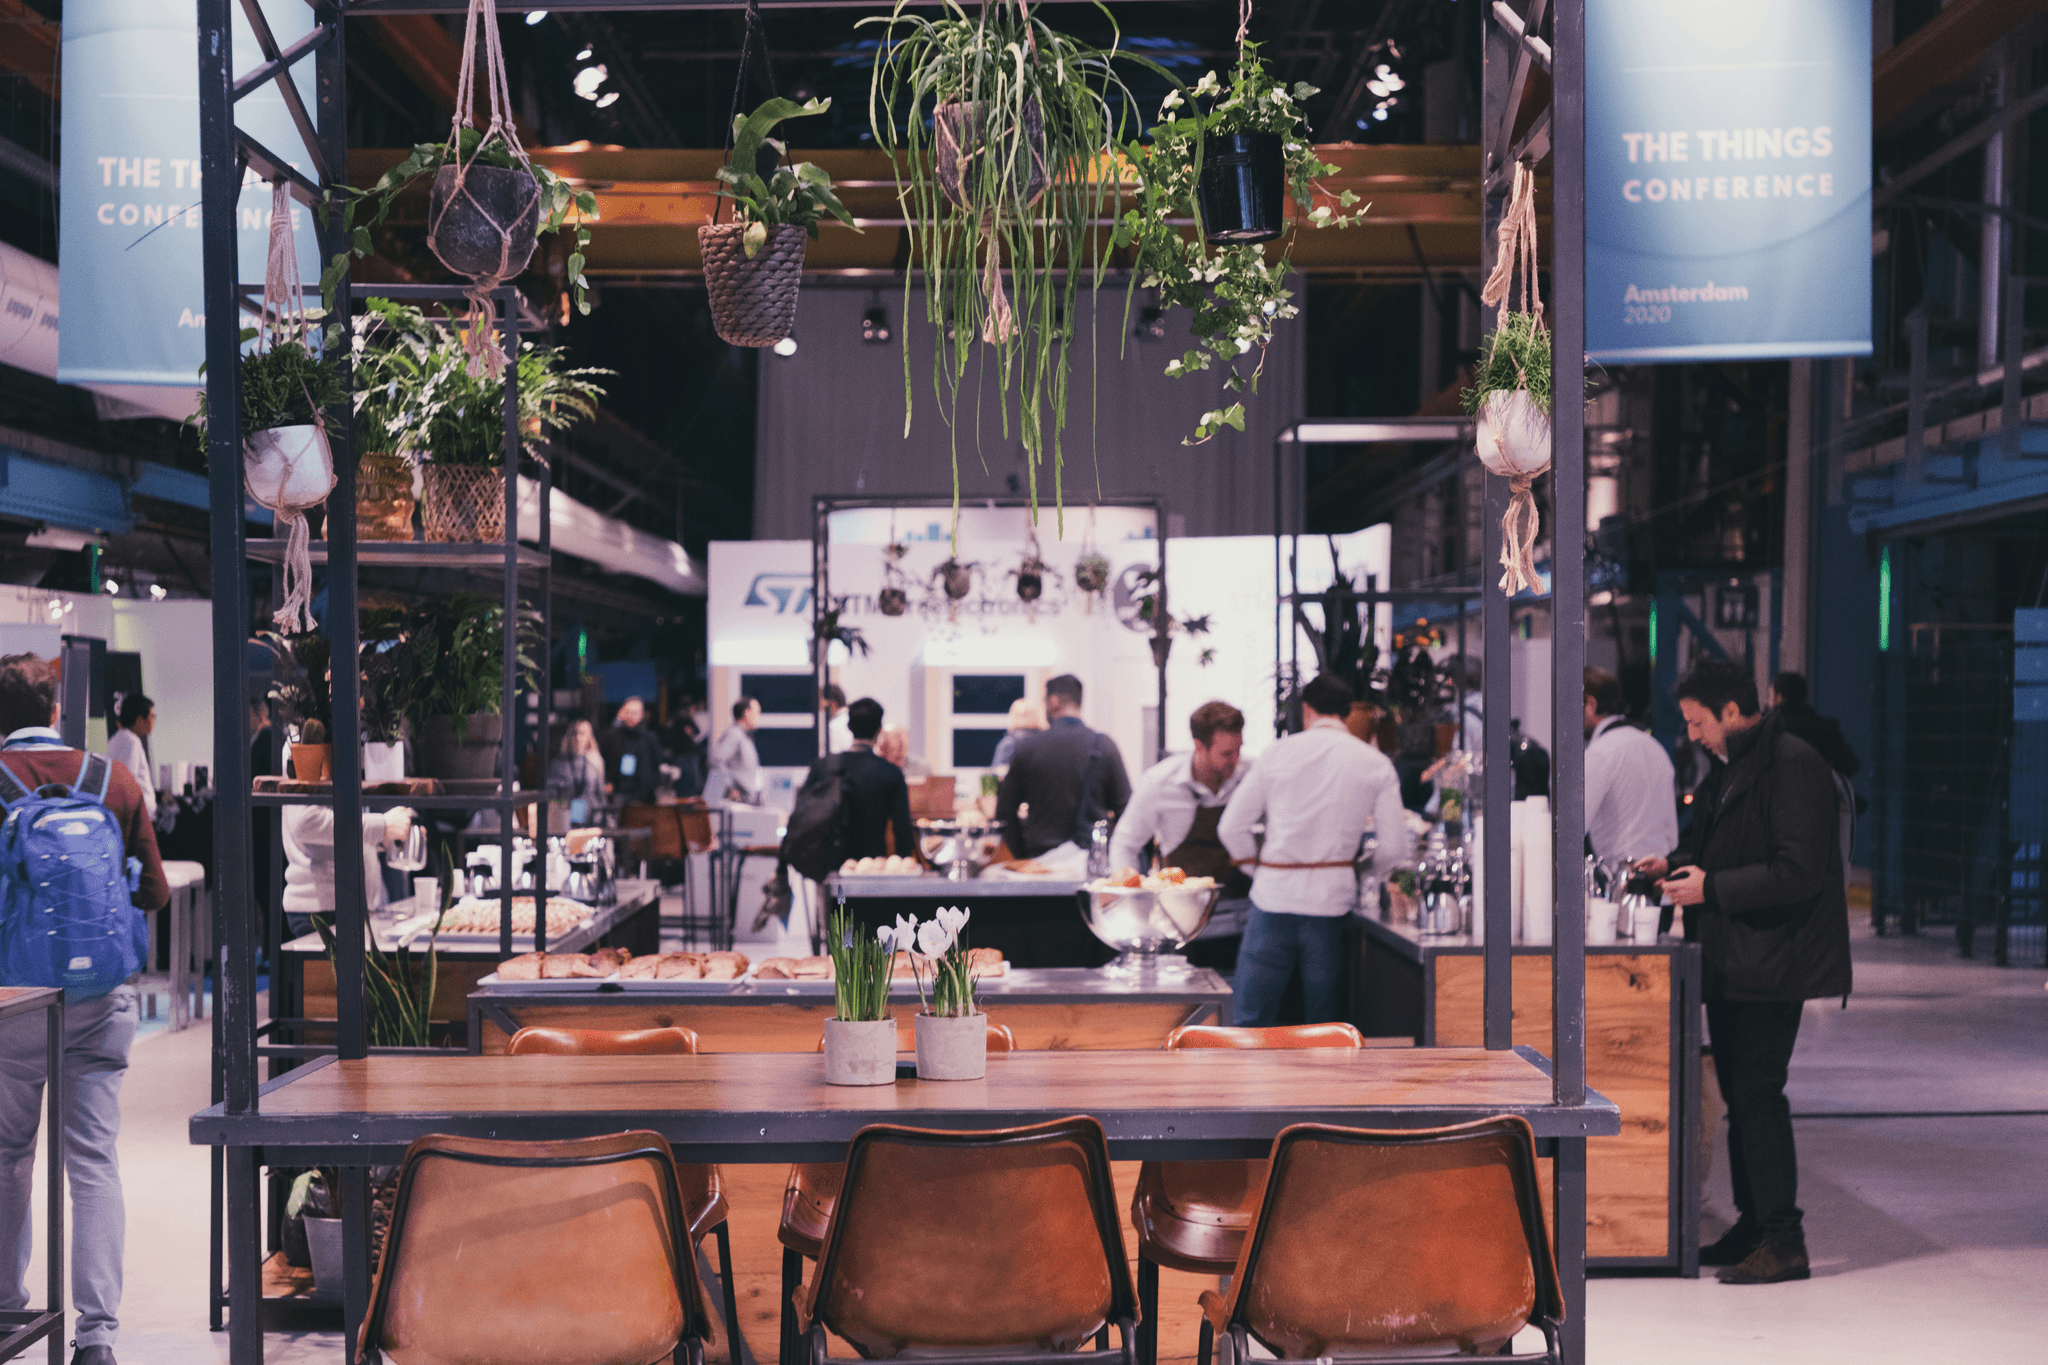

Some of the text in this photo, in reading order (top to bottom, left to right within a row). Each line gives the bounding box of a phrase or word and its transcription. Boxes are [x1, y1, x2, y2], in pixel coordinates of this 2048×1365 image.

[1622, 126, 1833, 163] THE THINGS
[97, 157, 161, 188] THE
[1622, 173, 1833, 202] CONFERENCE
[97, 202, 300, 231] CONFENE
[1624, 281, 1749, 304] Amsterdam
[1624, 304, 1671, 324] 2020
